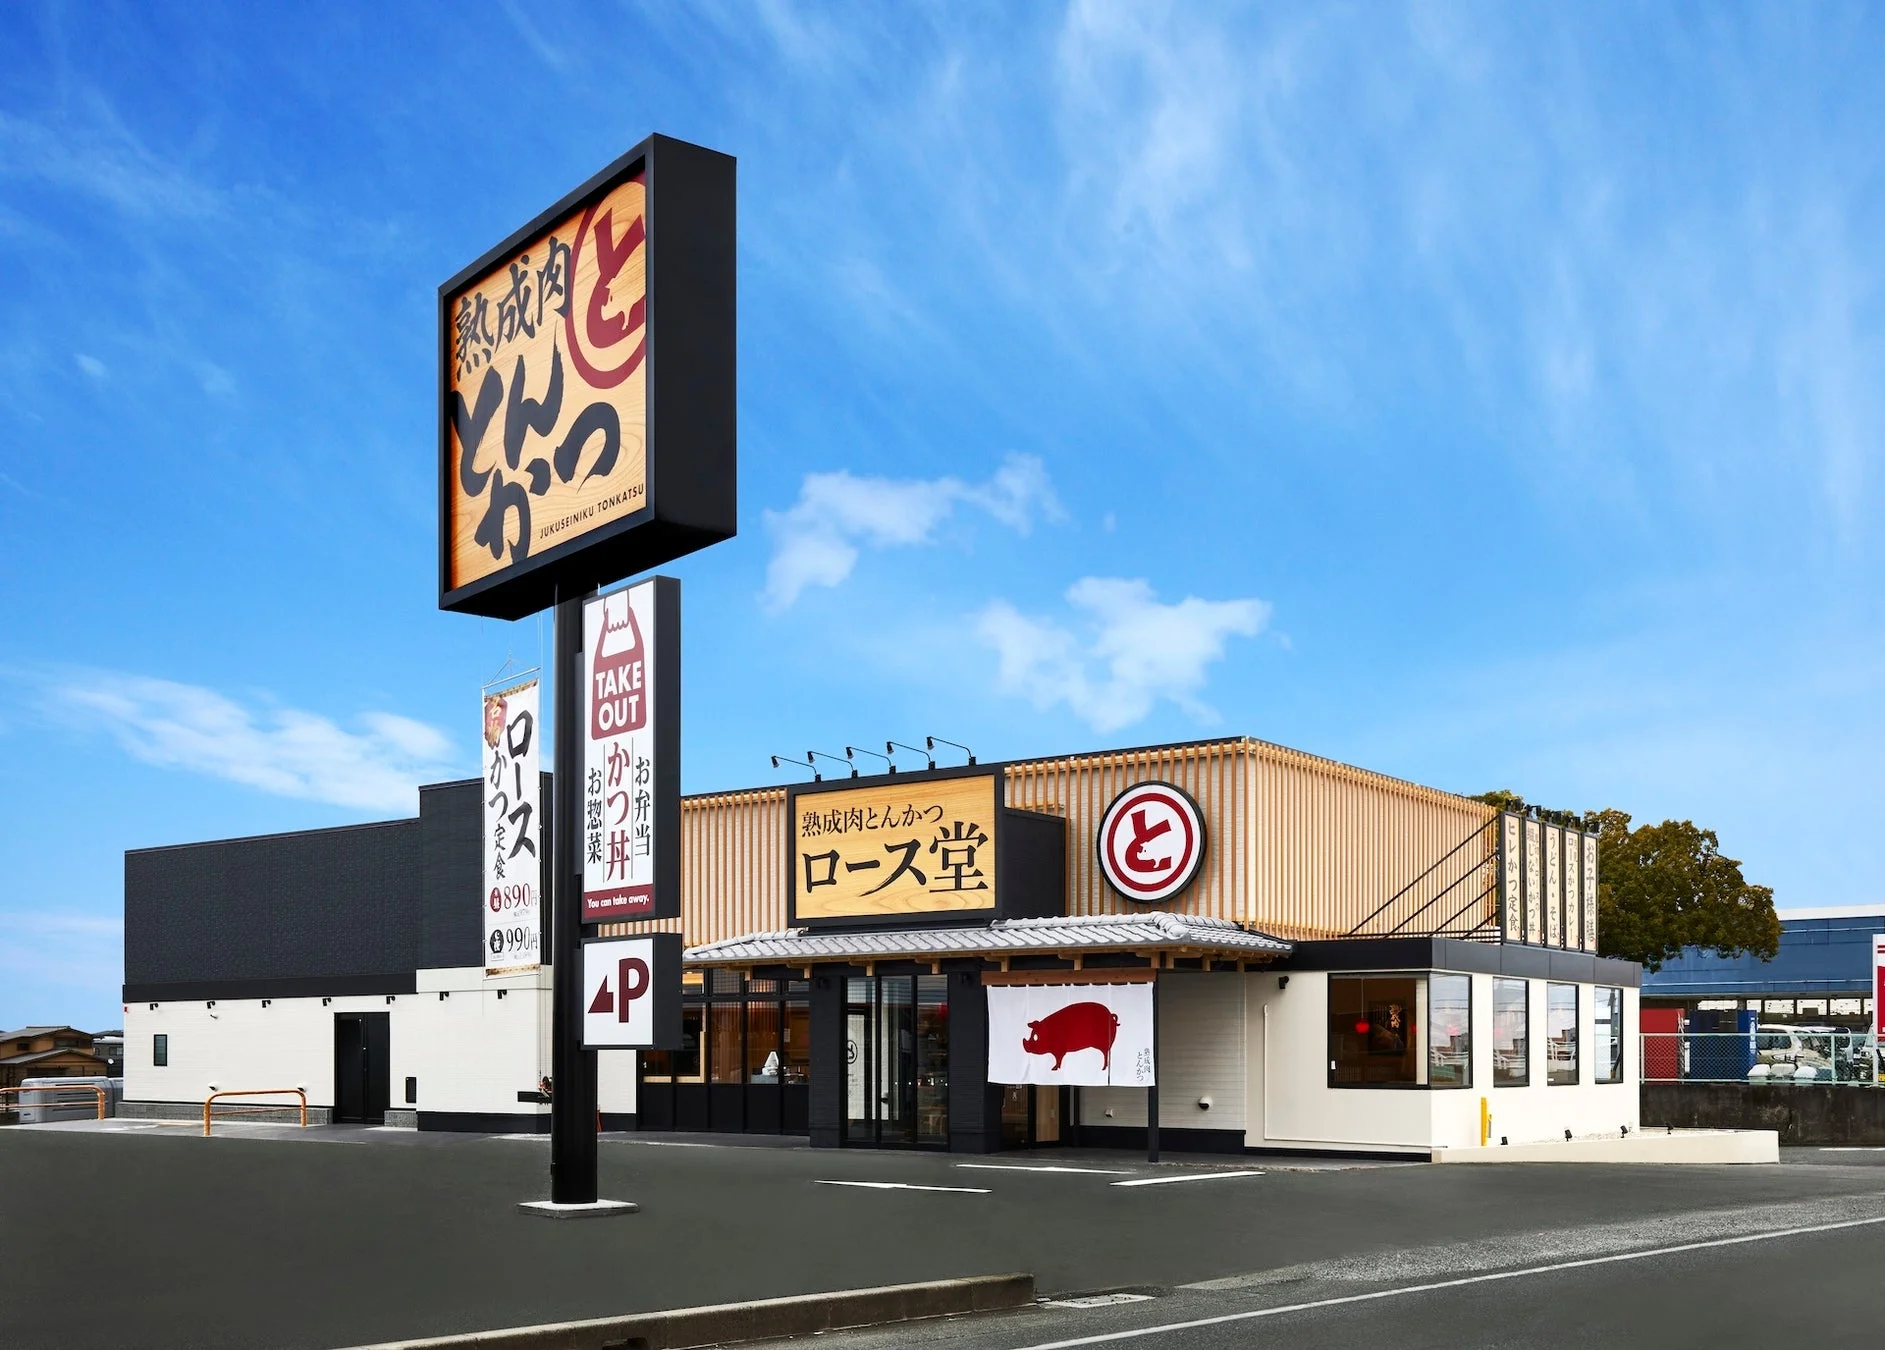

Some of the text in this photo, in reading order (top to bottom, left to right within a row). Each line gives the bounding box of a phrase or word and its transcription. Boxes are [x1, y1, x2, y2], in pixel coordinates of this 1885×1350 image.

[455, 237, 571, 380] 熟成肉
[540, 483, 644, 539] JUKUSEINIKU TONKATSU
[595, 661, 642, 700] TAKE
[598, 695, 640, 731] OUT
[488, 750, 508, 880] かつ定食
[507, 709, 537, 859] ロース
[587, 767, 602, 864] お惣菜
[606, 741, 630, 881] かつ丼
[634, 756, 651, 856] お弁当
[801, 803, 944, 838] 熟成肉とんかつ
[801, 820, 989, 897] ロース堂
[1125, 809, 1172, 873] と
[1507, 820, 1519, 932] ヒレかつ定食
[1548, 833, 1558, 940] うどん・そば
[1567, 837, 1576, 941] ロースかつカレー
[587, 893, 650, 909] You can take away.
[618, 957, 650, 1023] P
